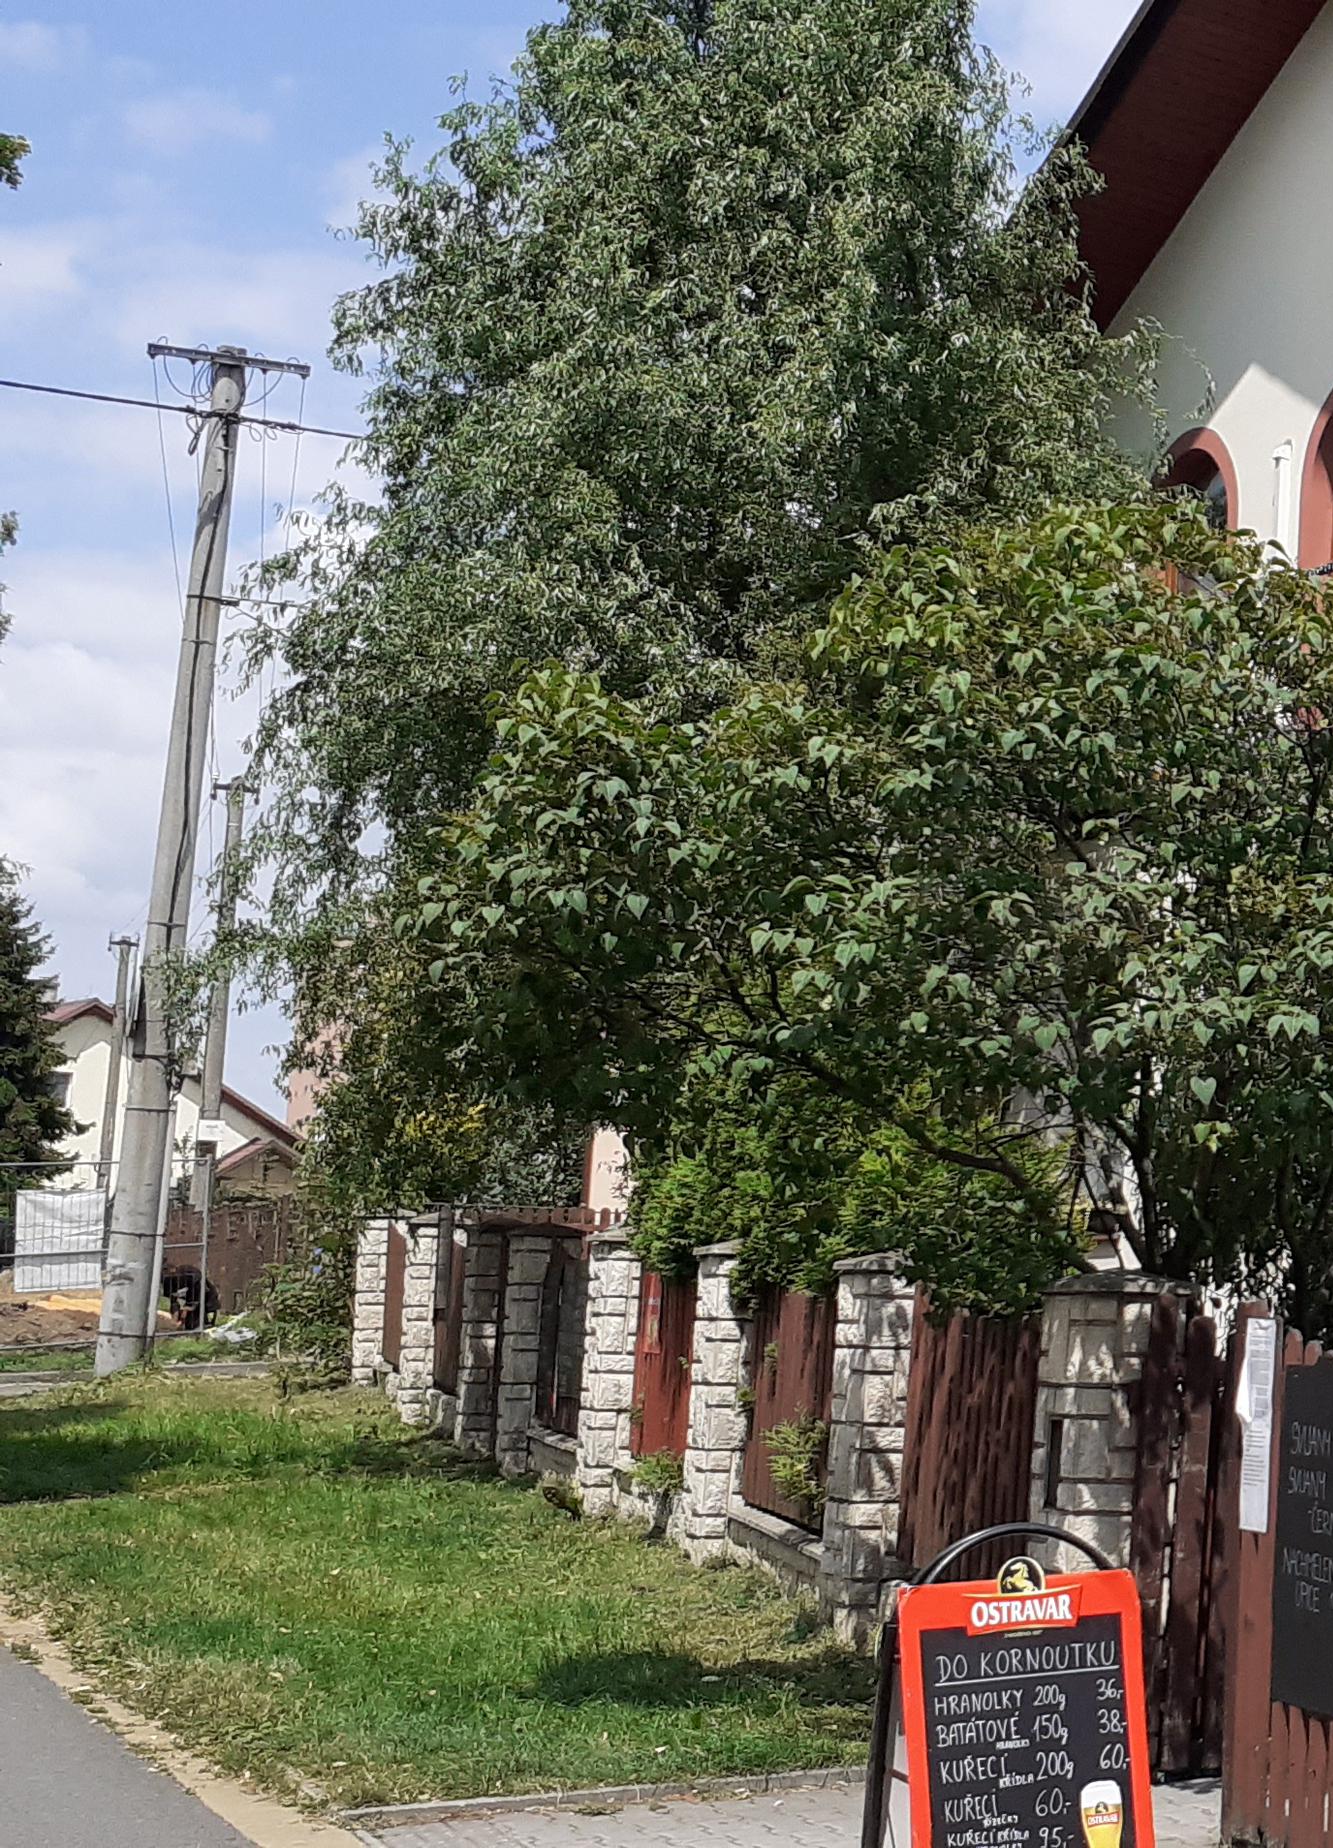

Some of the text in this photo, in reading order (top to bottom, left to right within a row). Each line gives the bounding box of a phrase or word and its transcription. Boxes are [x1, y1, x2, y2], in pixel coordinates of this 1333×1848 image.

[970, 1594, 1073, 1628] OSTRAVAR
[936, 1640, 1115, 1683] DO KORNOUTKU
[934, 1688, 1024, 1716] HRANOLKY
[1033, 1684, 1066, 1711] 200g
[936, 1711, 1021, 1748] BATÁTOVÉ
[1031, 1713, 1069, 1745] 150g
[940, 1753, 1009, 1785] KUŘECÍ
[1036, 1751, 1075, 1781] 200g
[999, 1770, 1035, 1789] KŘÍDLA
[944, 1787, 999, 1823] KUŘECÍ
[946, 1827, 995, 1848] KUŘECÍ
